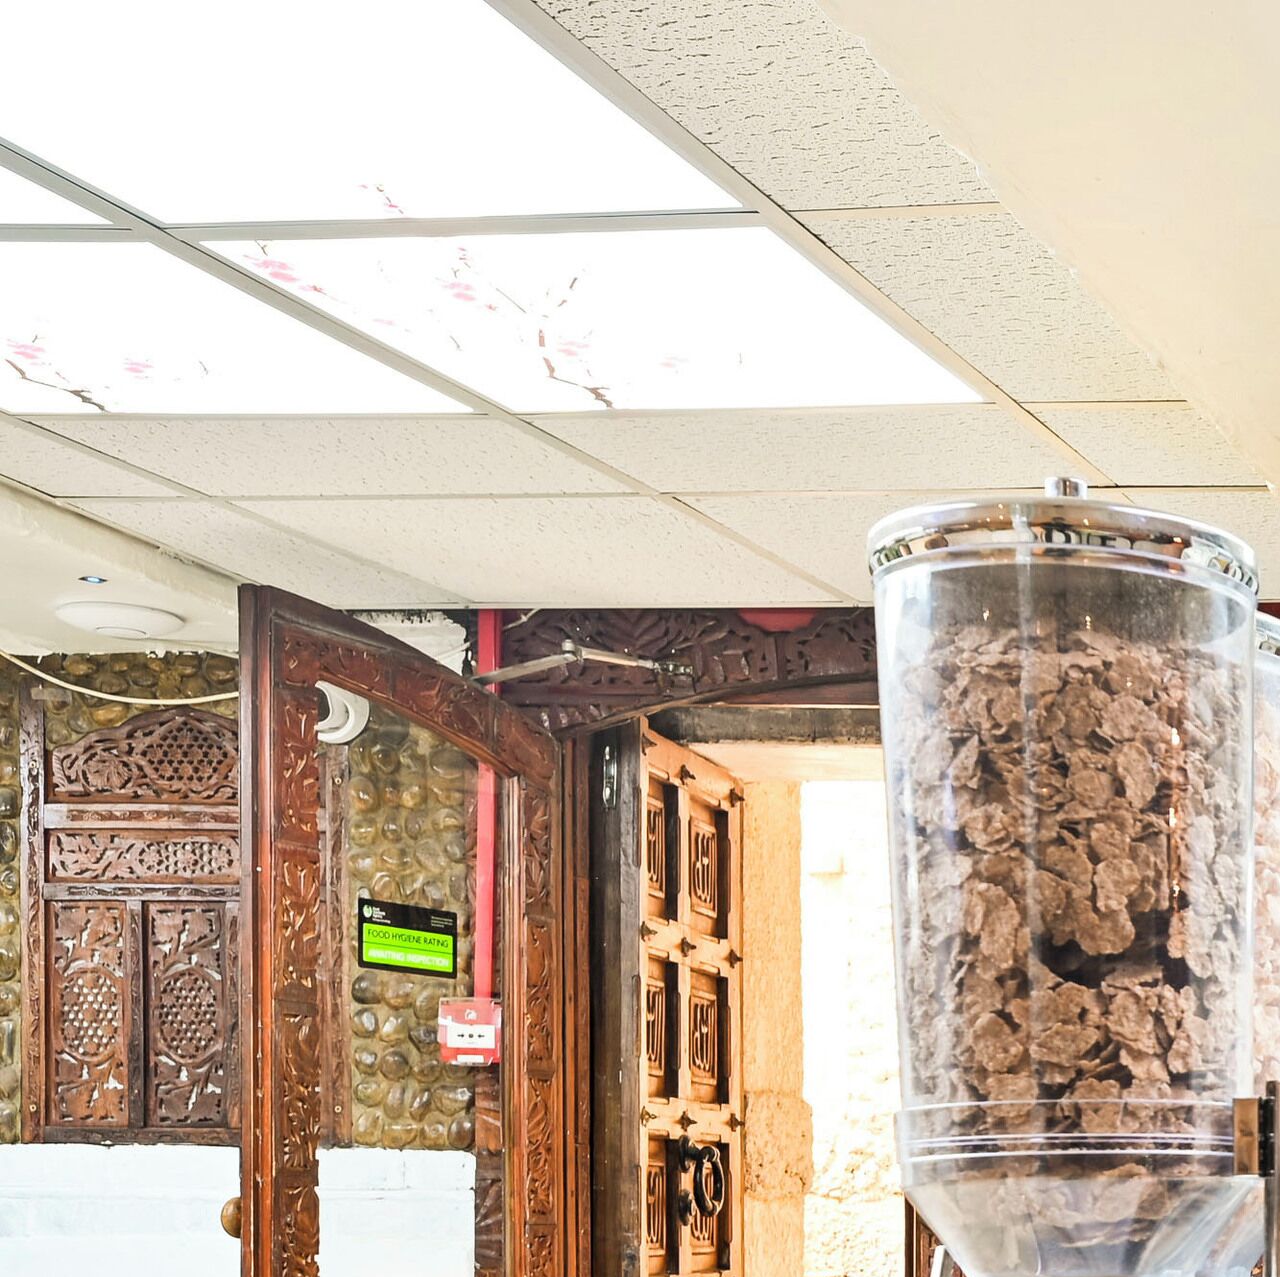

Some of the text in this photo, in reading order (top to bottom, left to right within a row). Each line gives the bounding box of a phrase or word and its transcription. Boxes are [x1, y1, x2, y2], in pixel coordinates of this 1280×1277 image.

[367, 928, 449, 949] FOOD HYGIENE RATING
